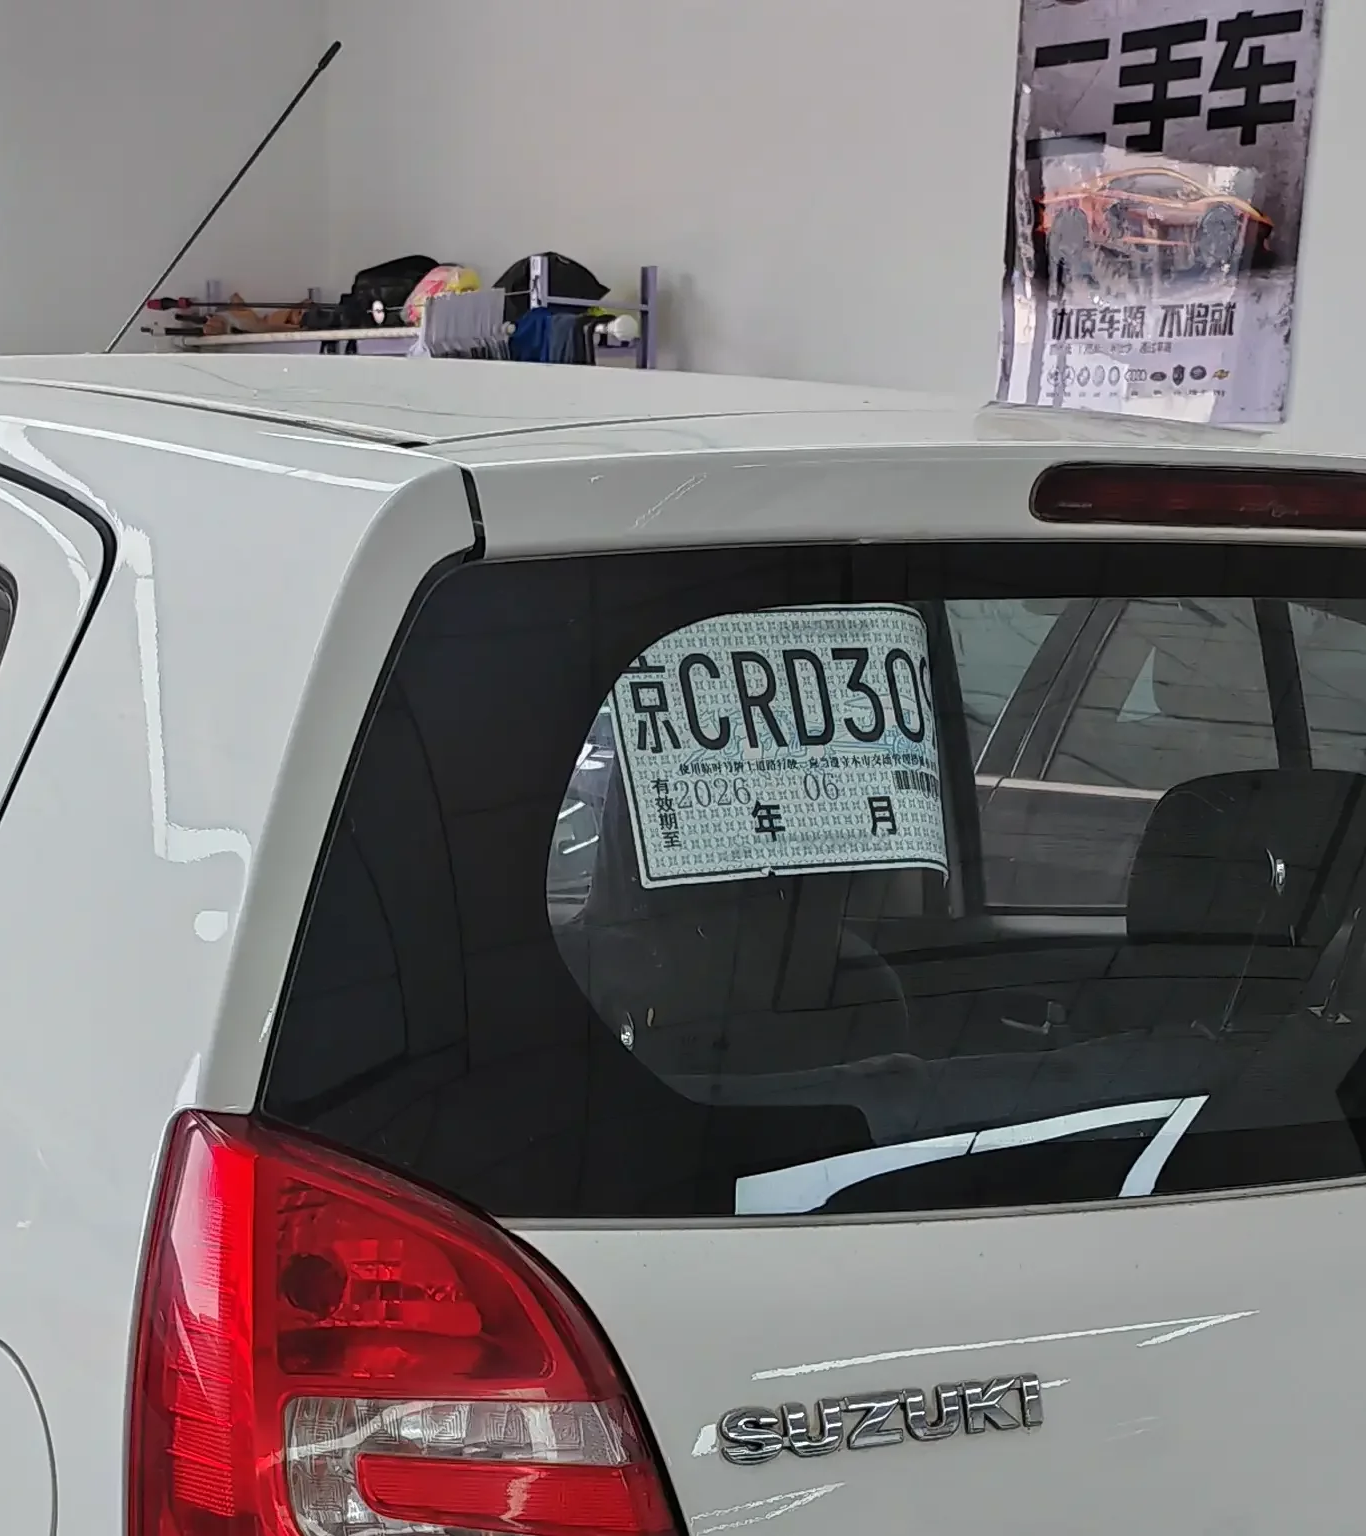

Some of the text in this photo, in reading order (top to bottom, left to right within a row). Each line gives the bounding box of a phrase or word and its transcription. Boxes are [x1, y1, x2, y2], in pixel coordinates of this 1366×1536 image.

[1026, 8, 1304, 160] 二手车
[1158, 301, 1237, 339] 不将就
[650, 778, 683, 849] 有效期至
[674, 770, 897, 842] 2026 年 06 月
[718, 1373, 1043, 1466] SUZUKI
